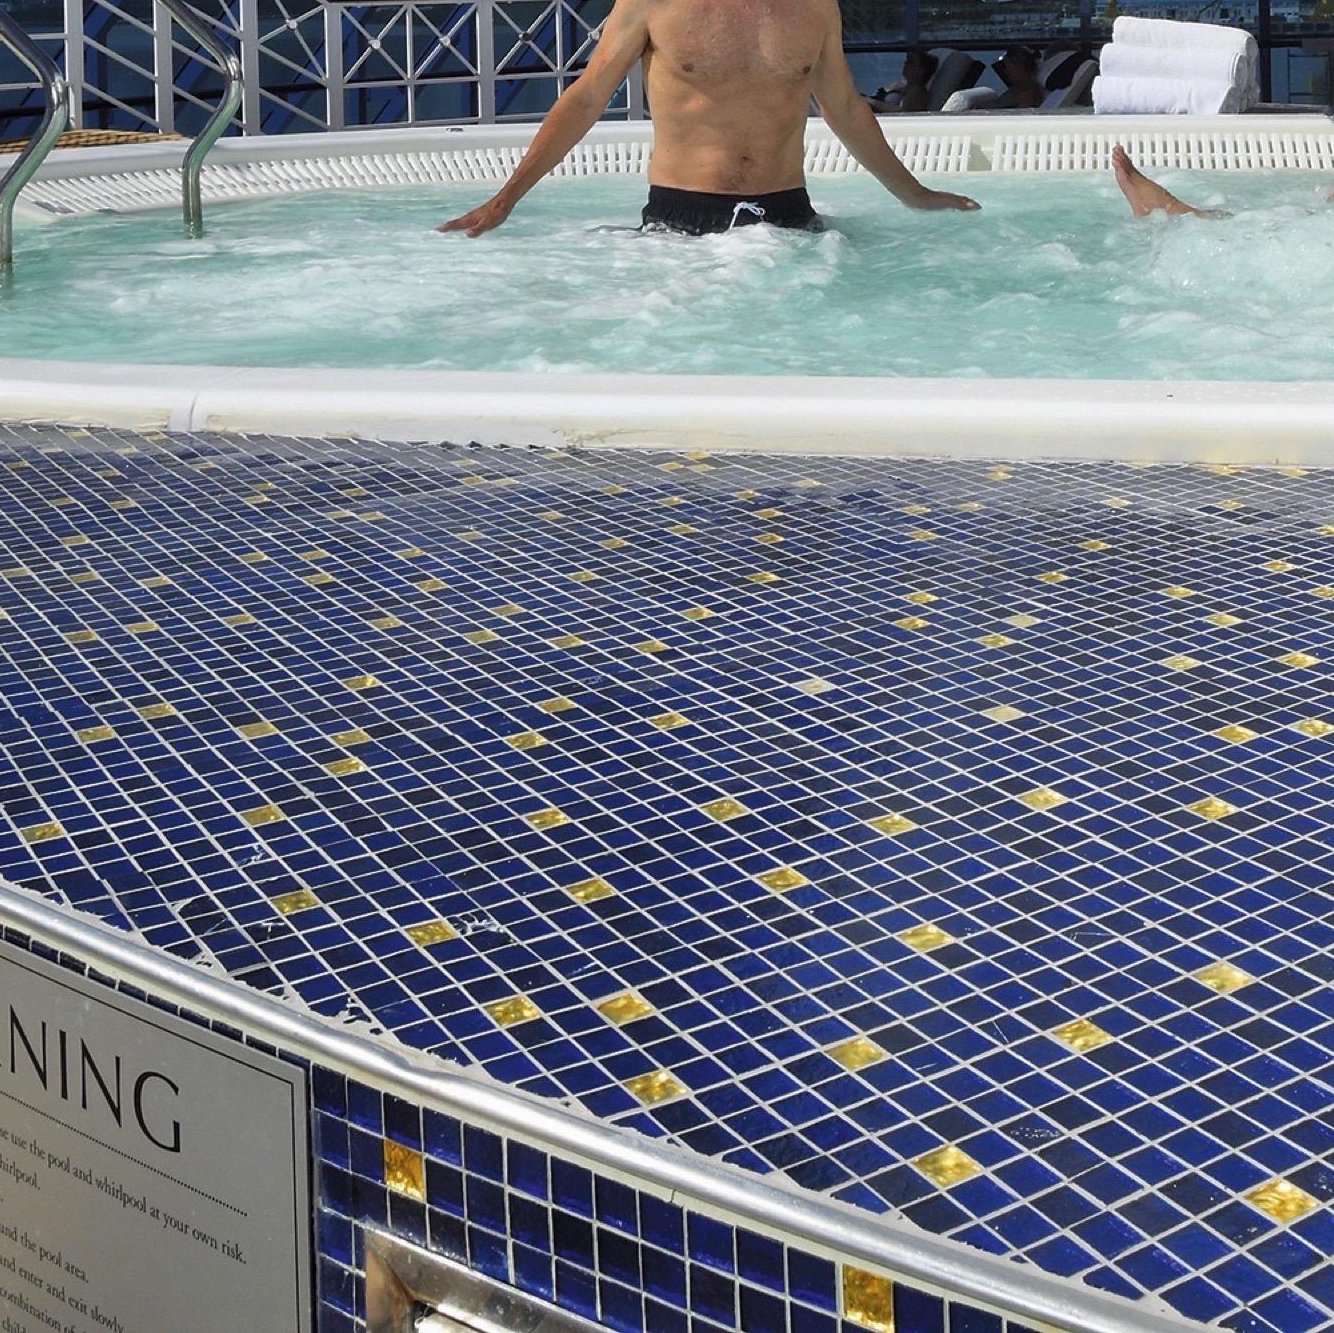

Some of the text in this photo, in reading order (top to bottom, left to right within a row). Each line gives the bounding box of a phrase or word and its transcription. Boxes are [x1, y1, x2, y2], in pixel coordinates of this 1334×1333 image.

[11, 1133, 27, 1150] use
[29, 1139, 45, 1160] the
[48, 1153, 70, 1173] pool
[72, 1167, 93, 1185] and
[95, 1177, 147, 1213] whirlpool
[149, 1206, 160, 1221] at
[163, 1212, 190, 1234] your
[191, 1227, 218, 1250] own
[221, 1240, 247, 1264] risk.
[20, 1232, 37, 1253] the
[39, 1246, 62, 1267] pool
[64, 1261, 89, 1283] area.
[18, 1267, 43, 1288] enter
[46, 1283, 65, 1302] and
[68, 1296, 88, 1315] exit
[90, 1305, 124, 1333] slowly
